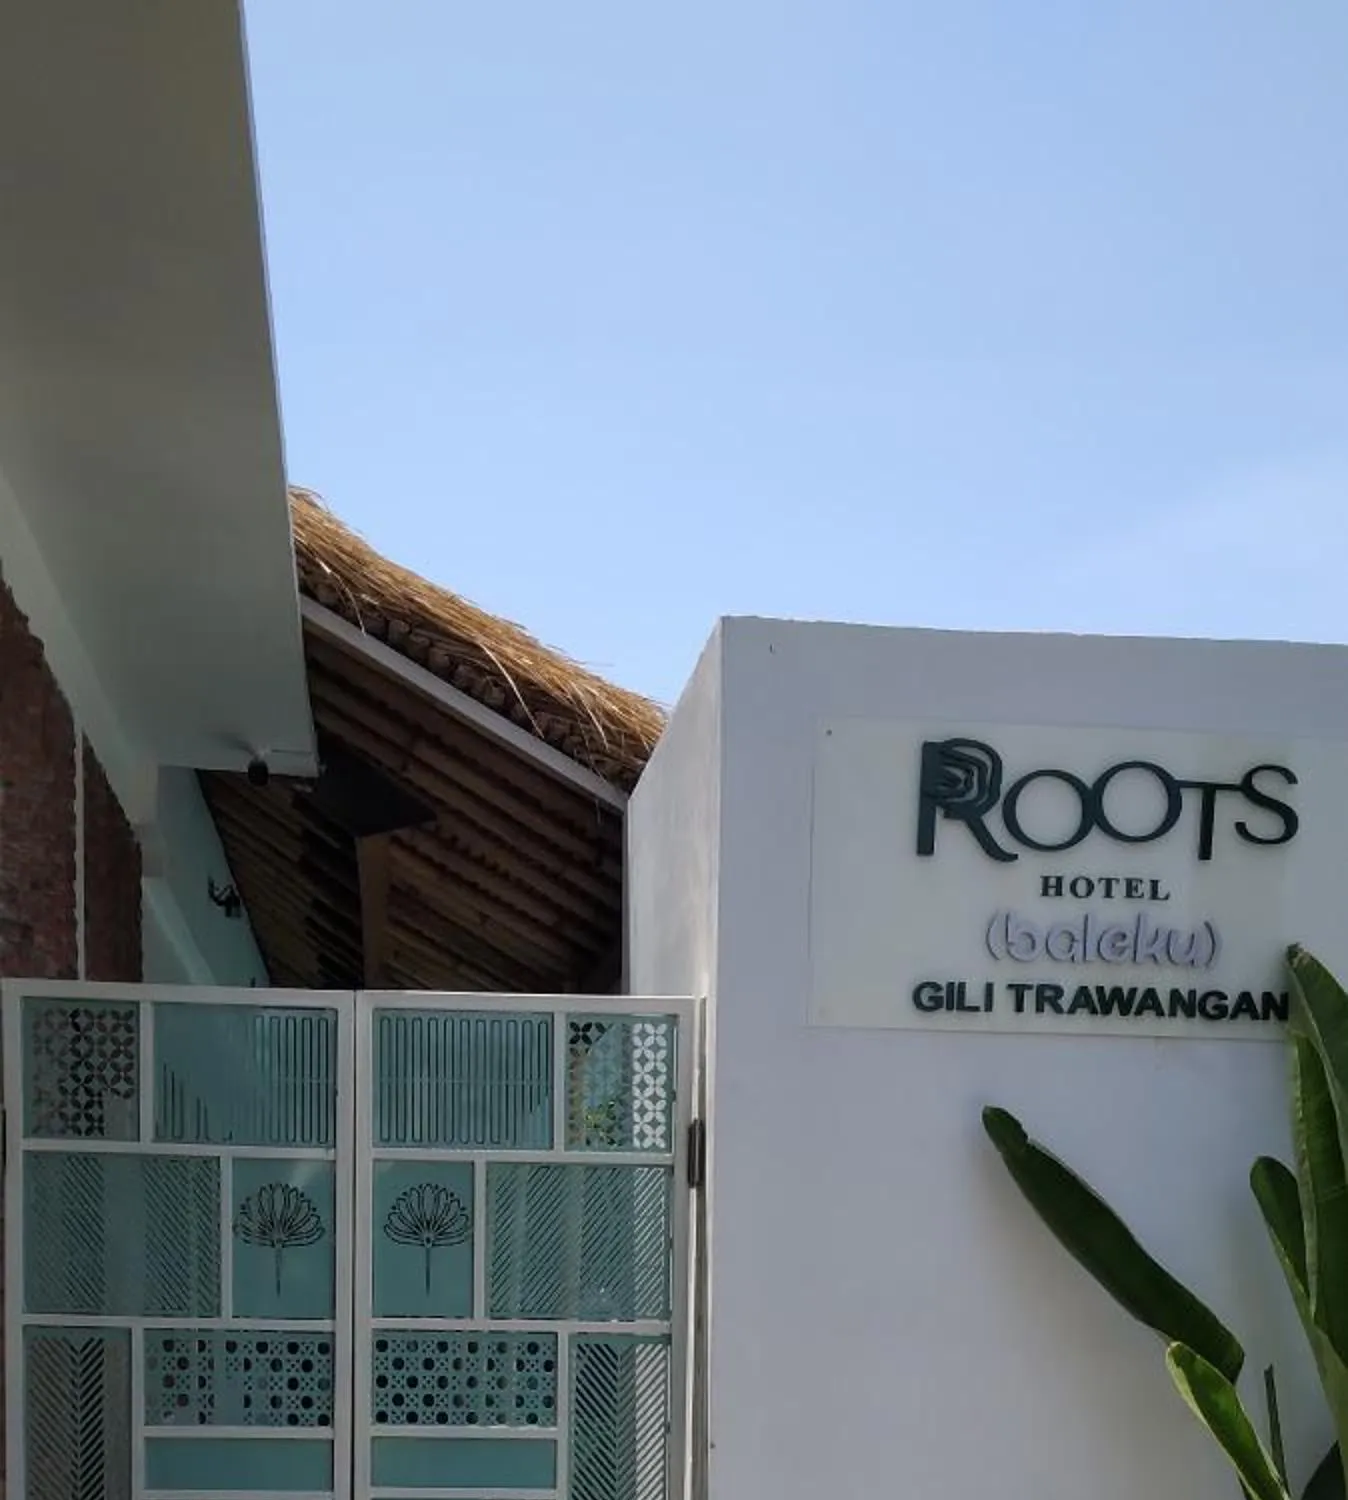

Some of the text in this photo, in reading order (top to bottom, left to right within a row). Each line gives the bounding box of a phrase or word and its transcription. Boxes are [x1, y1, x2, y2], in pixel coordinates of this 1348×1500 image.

[916, 737, 1299, 862] ROOTS
[1039, 875, 1171, 901] HOTEL
[912, 981, 1290, 1022] GILI TRAWANGAN
